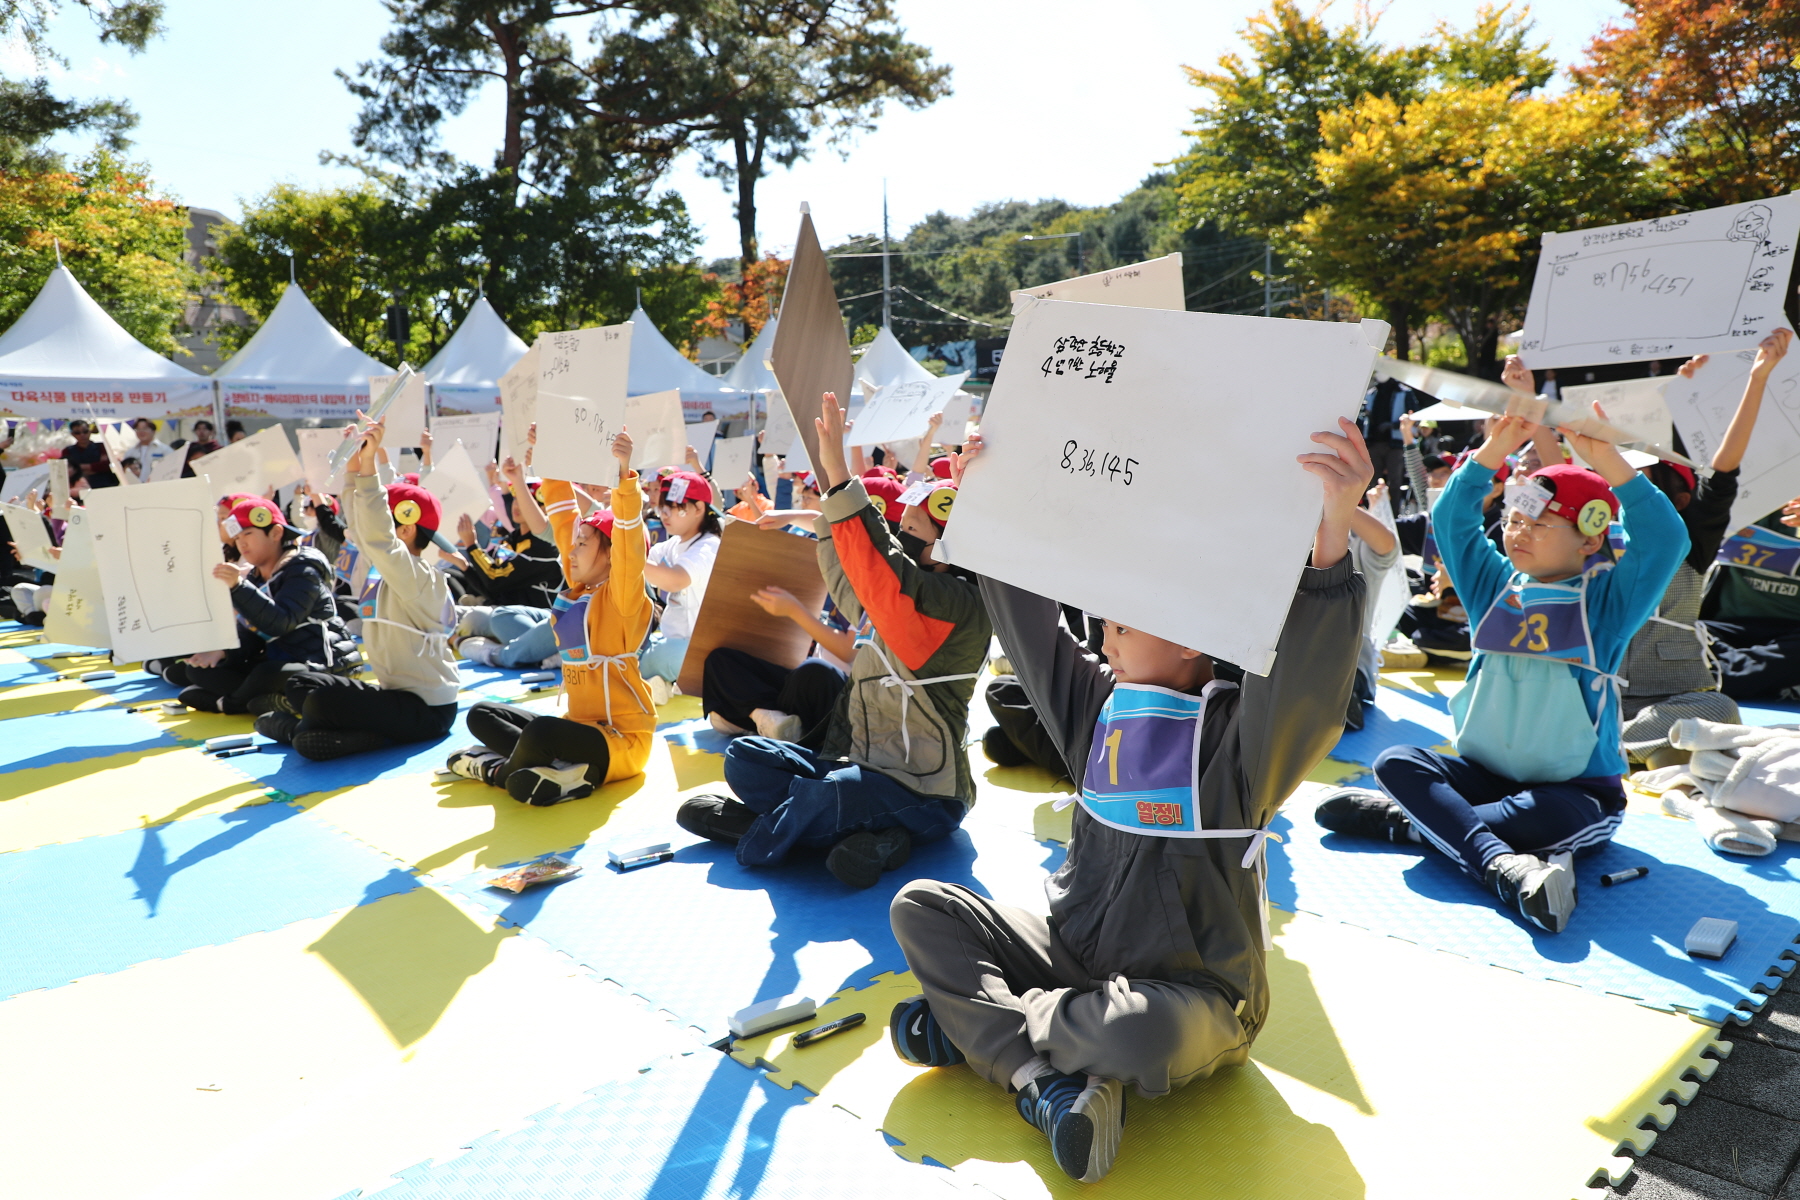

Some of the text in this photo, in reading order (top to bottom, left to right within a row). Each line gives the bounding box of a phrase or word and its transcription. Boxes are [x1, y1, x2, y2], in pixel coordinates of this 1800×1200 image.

[1053, 335, 1126, 358] 삼각산 초등학교
[11, 391, 167, 403] 다육식물 테라리움 만들기
[1060, 439, 1140, 486] 8,36,145
[402, 507, 414, 518] 4
[937, 496, 954, 513] 2
[256, 512, 266, 523] 5
[1585, 506, 1607, 529] 13
[1733, 543, 1776, 567] 37
[1509, 613, 1549, 652] 13
[1105, 728, 1123, 786] 1
[1135, 800, 1183, 826] 열정!
